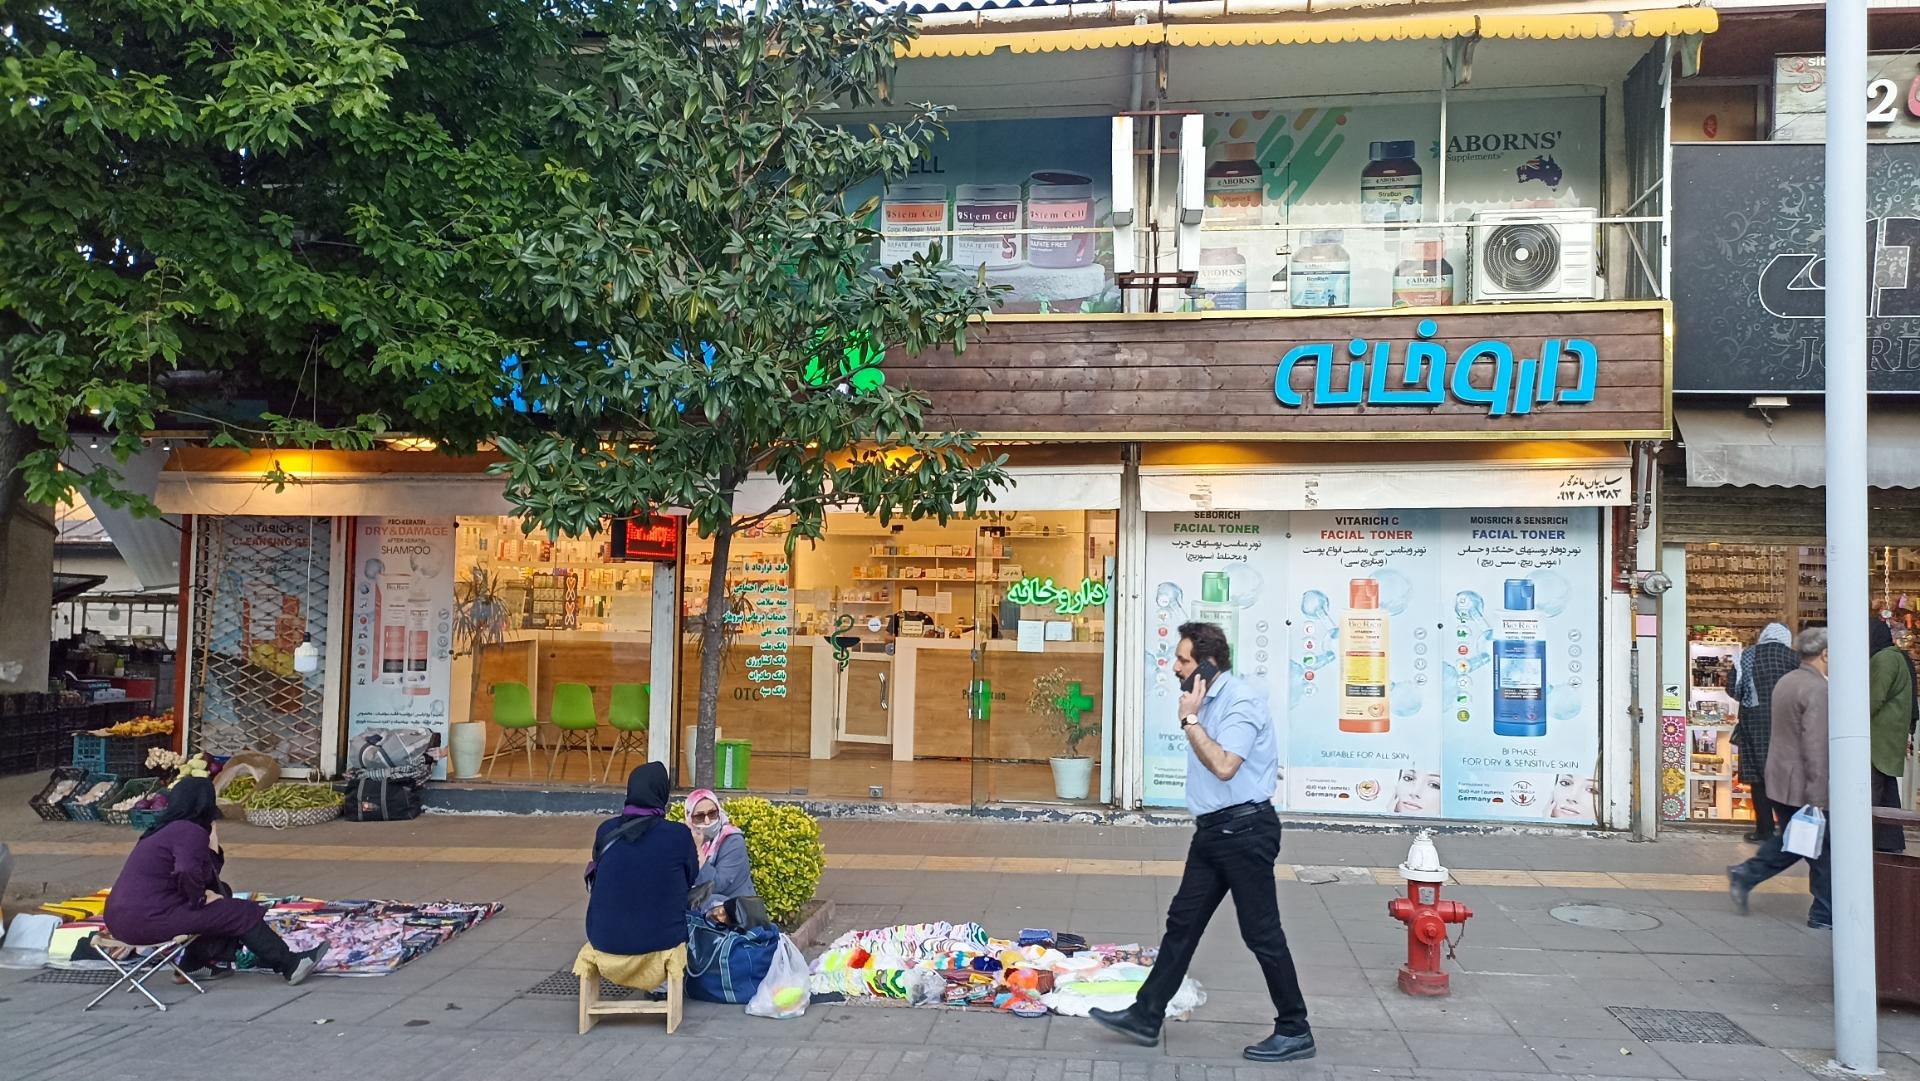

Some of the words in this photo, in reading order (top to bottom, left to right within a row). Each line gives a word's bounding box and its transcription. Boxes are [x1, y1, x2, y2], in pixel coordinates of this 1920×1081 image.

[1447, 131, 1562, 153] ABORNS'
[995, 210, 1015, 220] Cell
[1274, 318, 1599, 417] داروخانه
[1194, 511, 1241, 520] SEBORICH
[1470, 516, 1514, 525] MOISRICH
[1515, 516, 1522, 525] &
[1523, 516, 1569, 525] SENSRICH
[1335, 516, 1389, 526] VITARICH
[1391, 516, 1400, 526] C
[1173, 523, 1216, 534] FACIAL
[1218, 523, 1260, 535] TONER
[1320, 530, 1365, 540] FACIAL
[1369, 530, 1413, 540] TONER
[1472, 529, 1518, 540] FACIAL
[1520, 529, 1566, 540] TONER
[381, 545, 431, 555] SHAMPOO
[1007, 575, 1109, 614] داروخانه
[733, 687, 760, 701] OTC
[1320, 750, 1355, 759] SUITABLE
[1356, 751, 1374, 759] FOR
[1391, 752, 1410, 760] SKIN
[1502, 747, 1510, 756] BI
[1511, 748, 1537, 757] PHASE
[1462, 757, 1481, 767] FOR
[1483, 757, 1502, 767] DRY
[1505, 758, 1511, 767] &
[1514, 759, 1556, 769] SENSITIVE
[1559, 760, 1579, 769] SKIN
[1153, 779, 1184, 787] Germany
[1305, 790, 1338, 799] Germany
[1457, 794, 1491, 803] Germany
